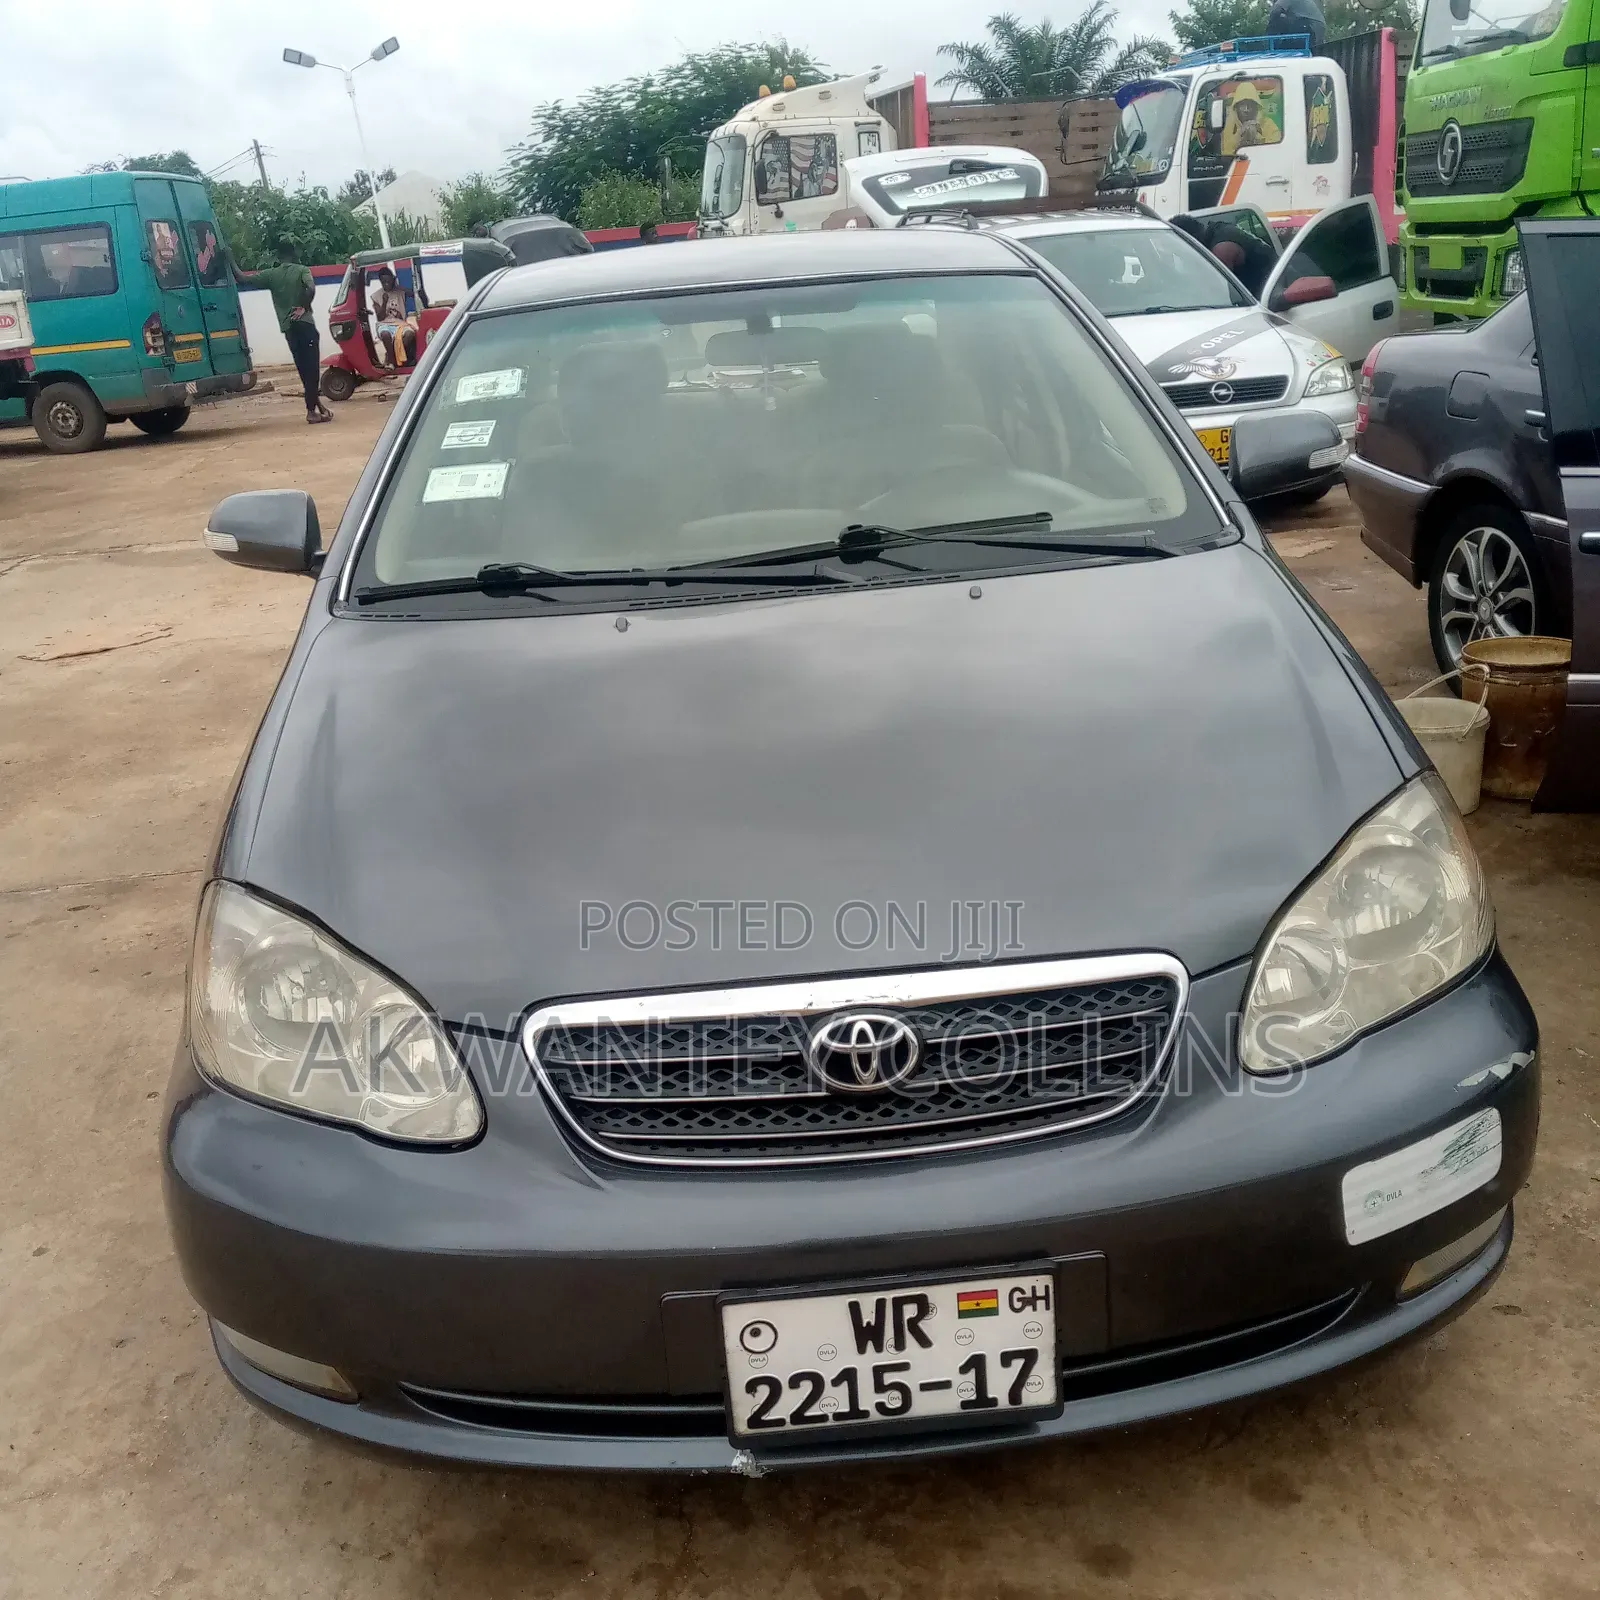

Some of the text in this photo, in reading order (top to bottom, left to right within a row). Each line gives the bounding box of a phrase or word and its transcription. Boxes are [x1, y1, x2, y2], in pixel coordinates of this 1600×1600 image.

[1201, 330, 1245, 349] OPEL
[1220, 429, 1232, 443] G
[1386, 1189, 1403, 1202] DVLA
[848, 1284, 1051, 1355] WR GH
[745, 1347, 1039, 1429] 2215-17
